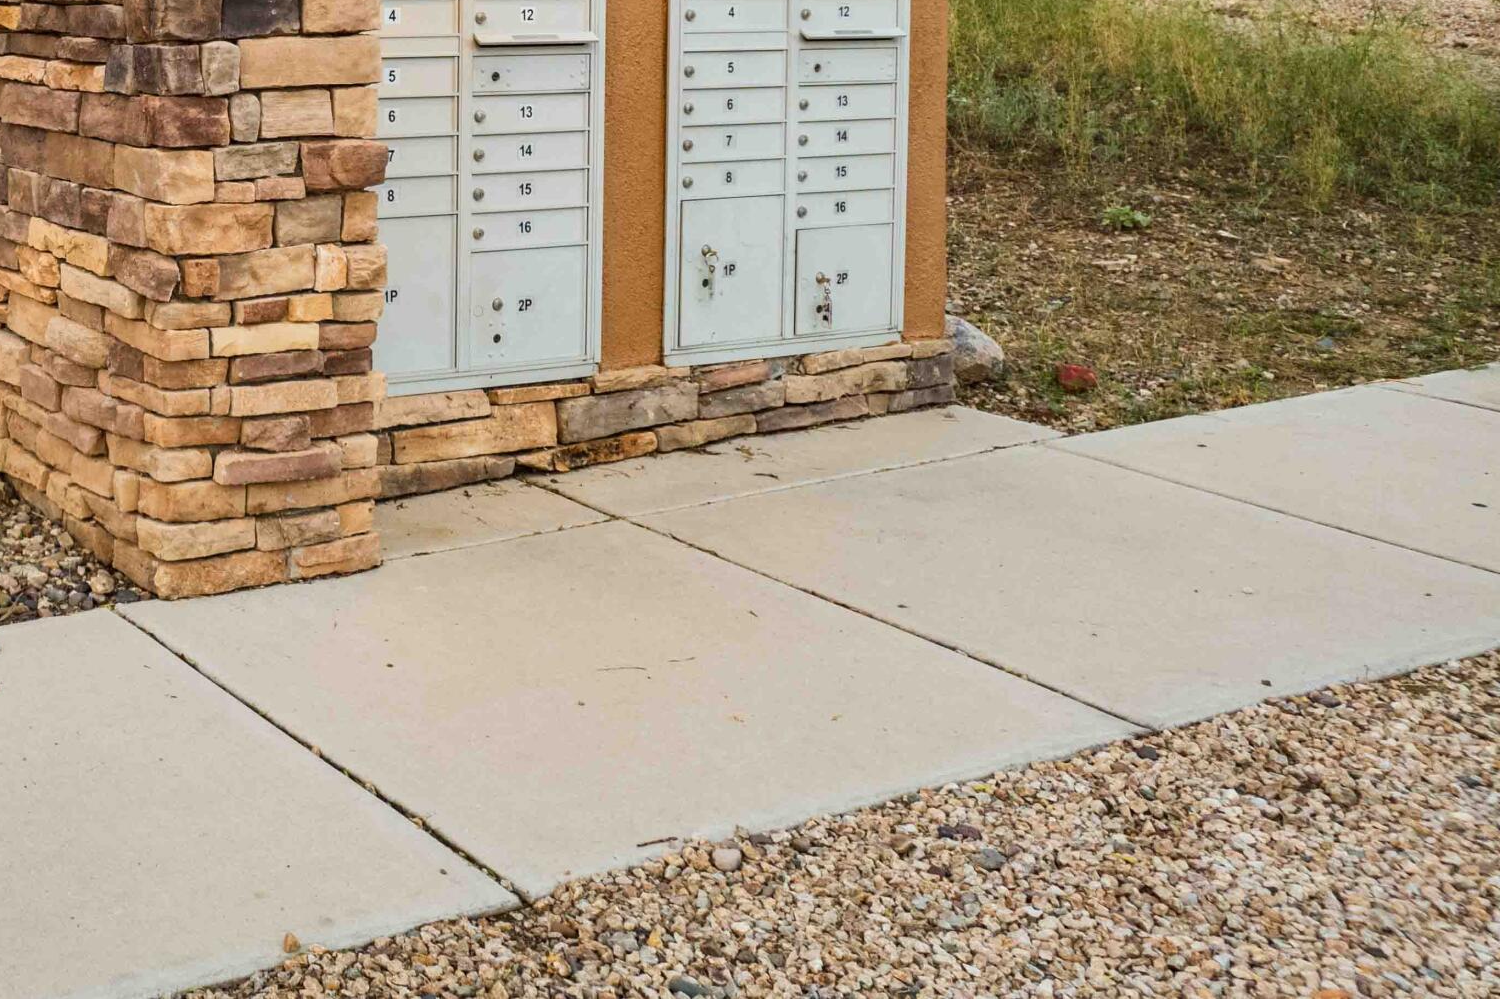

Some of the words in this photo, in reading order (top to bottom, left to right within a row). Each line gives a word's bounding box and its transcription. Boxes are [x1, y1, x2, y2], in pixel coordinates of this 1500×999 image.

[388, 9, 397, 22] 4
[521, 8, 534, 22] 12
[728, 6, 735, 18] 4
[838, 5, 850, 18] 12
[727, 61, 735, 74] 5
[388, 69, 397, 83] 5
[726, 98, 734, 111] 6
[836, 94, 849, 107] 13
[388, 109, 396, 123] 6
[519, 105, 533, 119] 13
[725, 134, 733, 147] 7
[836, 129, 848, 143] 14
[387, 149, 395, 162] 7
[519, 144, 533, 157] 14
[725, 171, 733, 184] 8
[835, 165, 847, 178] 15
[518, 182, 532, 196] 15
[387, 189, 395, 203] 8
[834, 200, 847, 214] 16
[518, 220, 532, 234] 16
[723, 263, 736, 277] 1P
[836, 272, 849, 285] 2P
[385, 290, 398, 303] 1P
[518, 298, 533, 312] 2P
